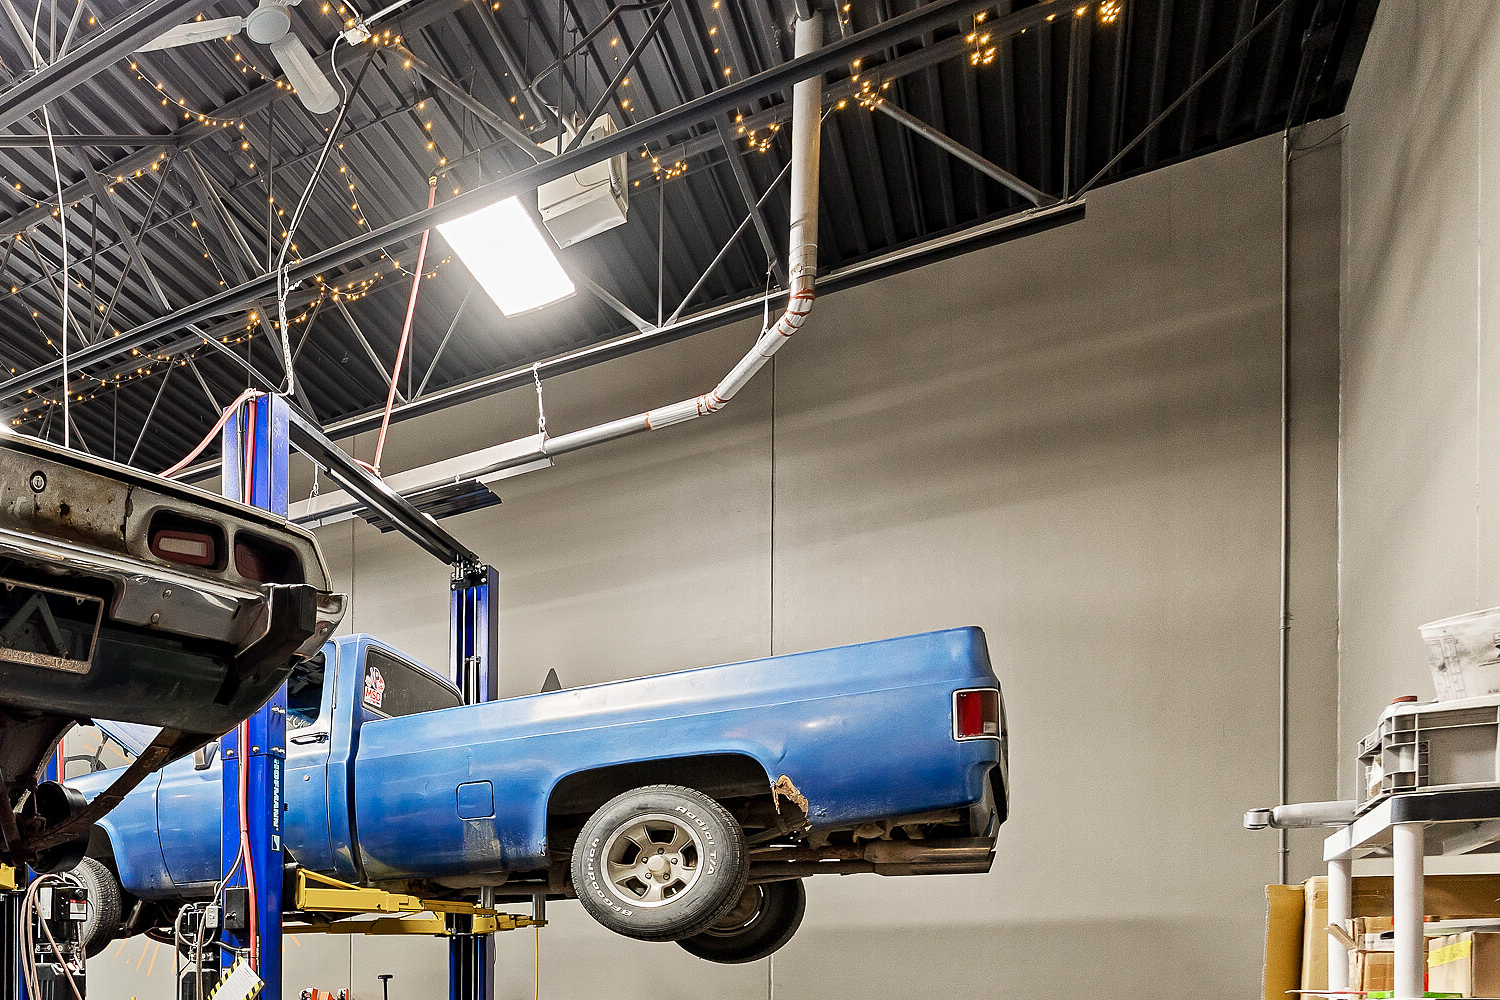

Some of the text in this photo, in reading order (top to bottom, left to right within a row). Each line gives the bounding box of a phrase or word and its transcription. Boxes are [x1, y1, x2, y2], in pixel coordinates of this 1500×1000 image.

[365, 687, 381, 702] MSD
[675, 806, 717, 875] Radial T/A
[587, 838, 634, 917] BFGoodrich
